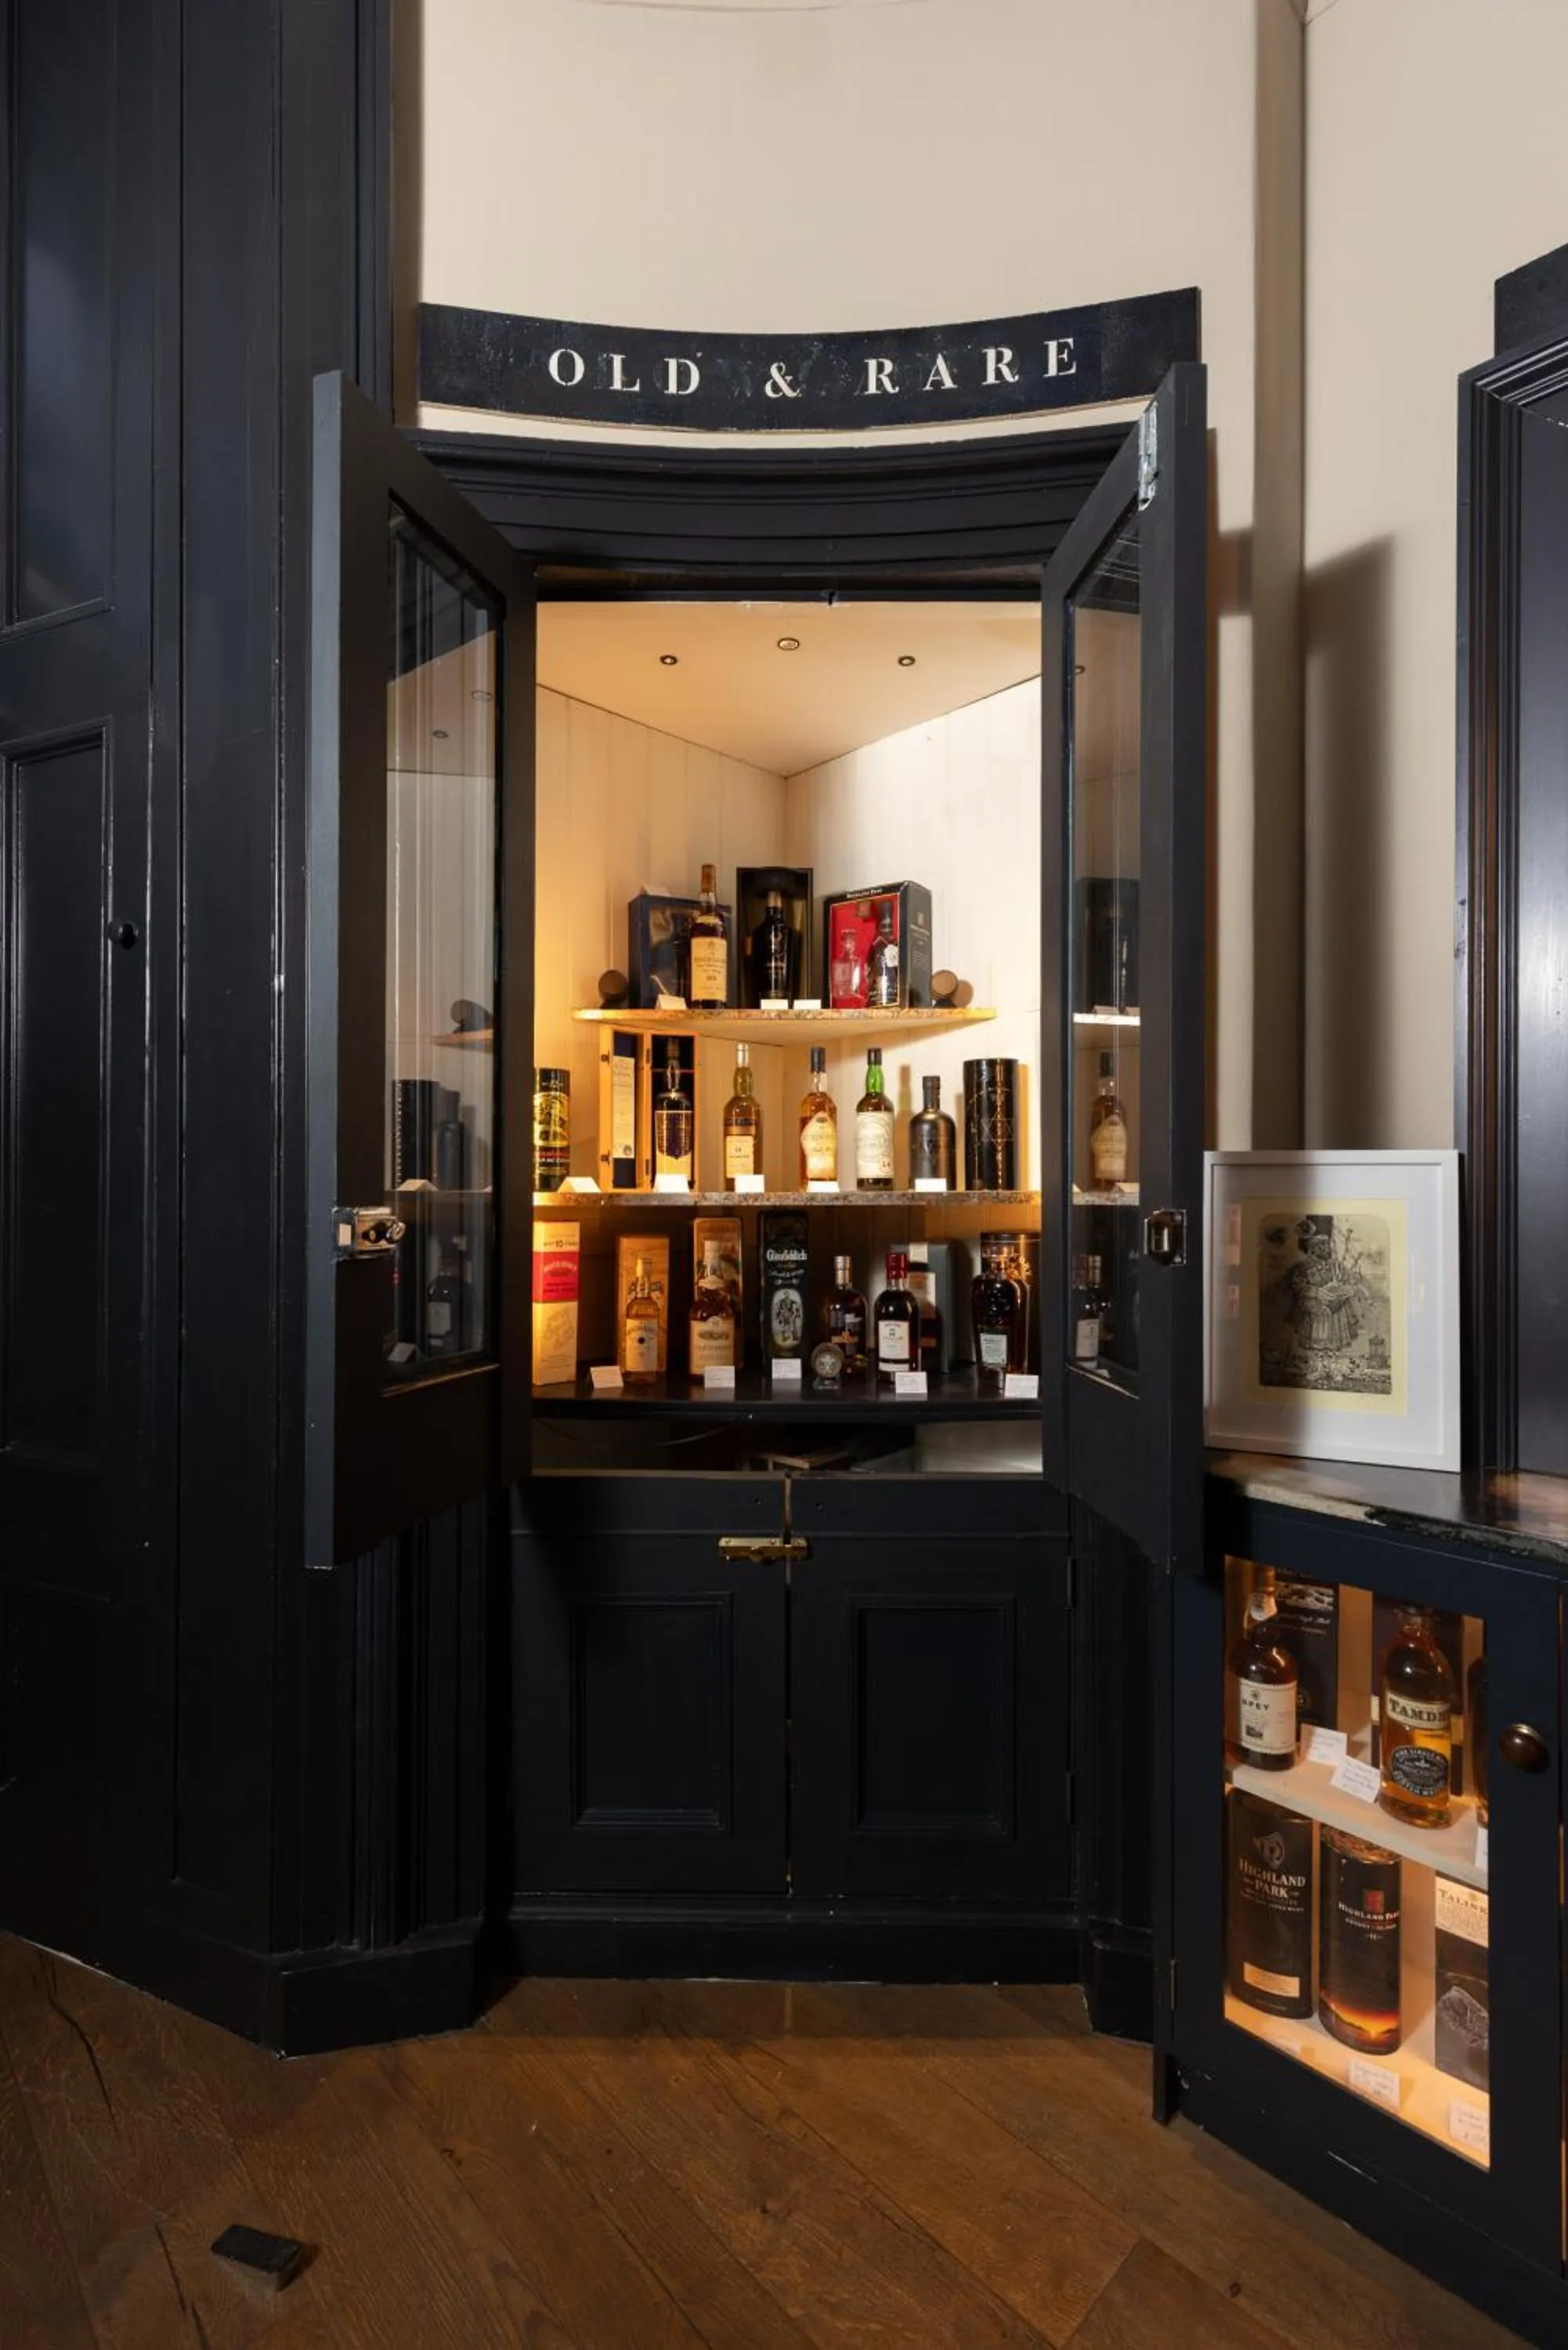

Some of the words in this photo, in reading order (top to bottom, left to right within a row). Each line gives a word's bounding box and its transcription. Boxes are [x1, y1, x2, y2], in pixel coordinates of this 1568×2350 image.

[548, 349, 700, 395] OLD
[764, 361, 801, 398] &
[864, 338, 1077, 395] RARE
[1239, 1857, 1306, 1888] HIGHLAND
[1255, 1878, 1288, 1898] PARK
[1339, 1901, 1384, 1920] HIGHLAND
